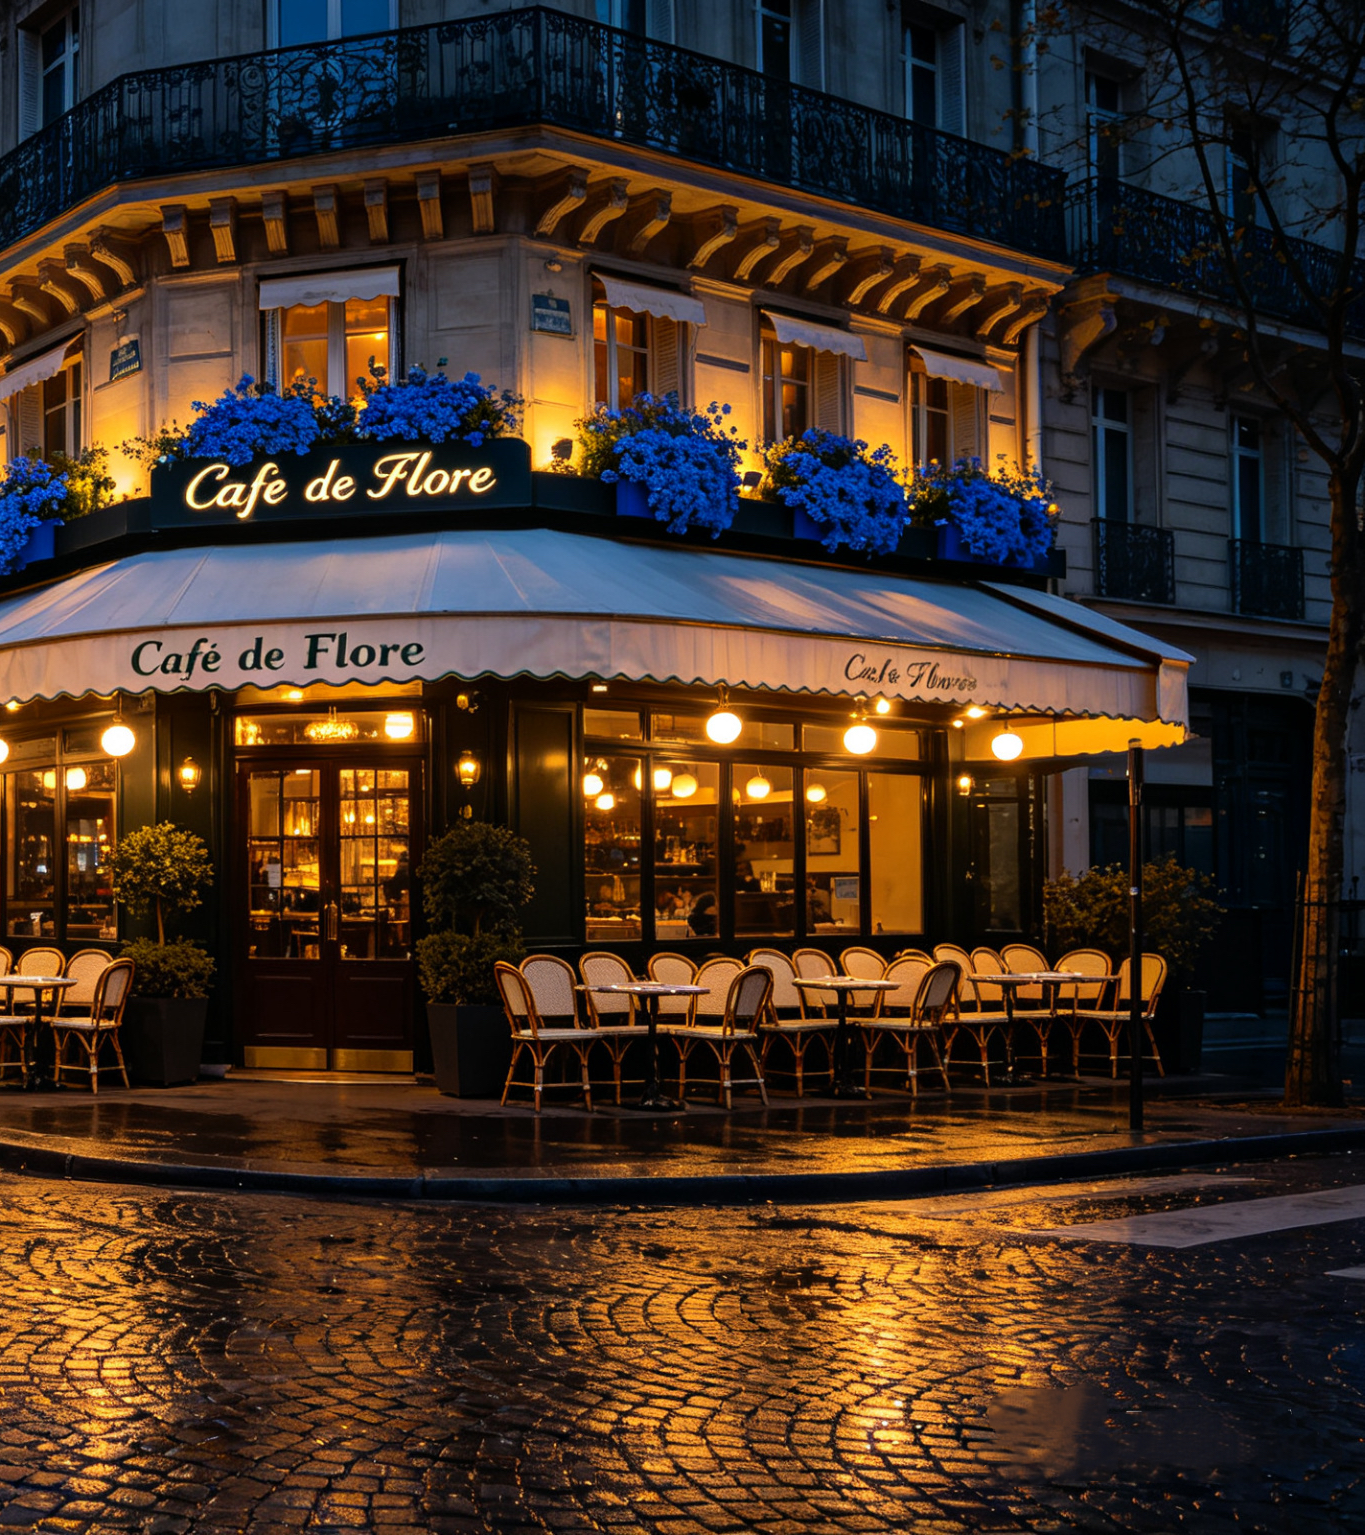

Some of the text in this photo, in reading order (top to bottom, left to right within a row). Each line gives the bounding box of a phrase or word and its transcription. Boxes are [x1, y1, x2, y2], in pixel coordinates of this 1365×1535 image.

[185, 450, 496, 519] Cafe de Flore
[131, 632, 426, 681] Café de Flore
